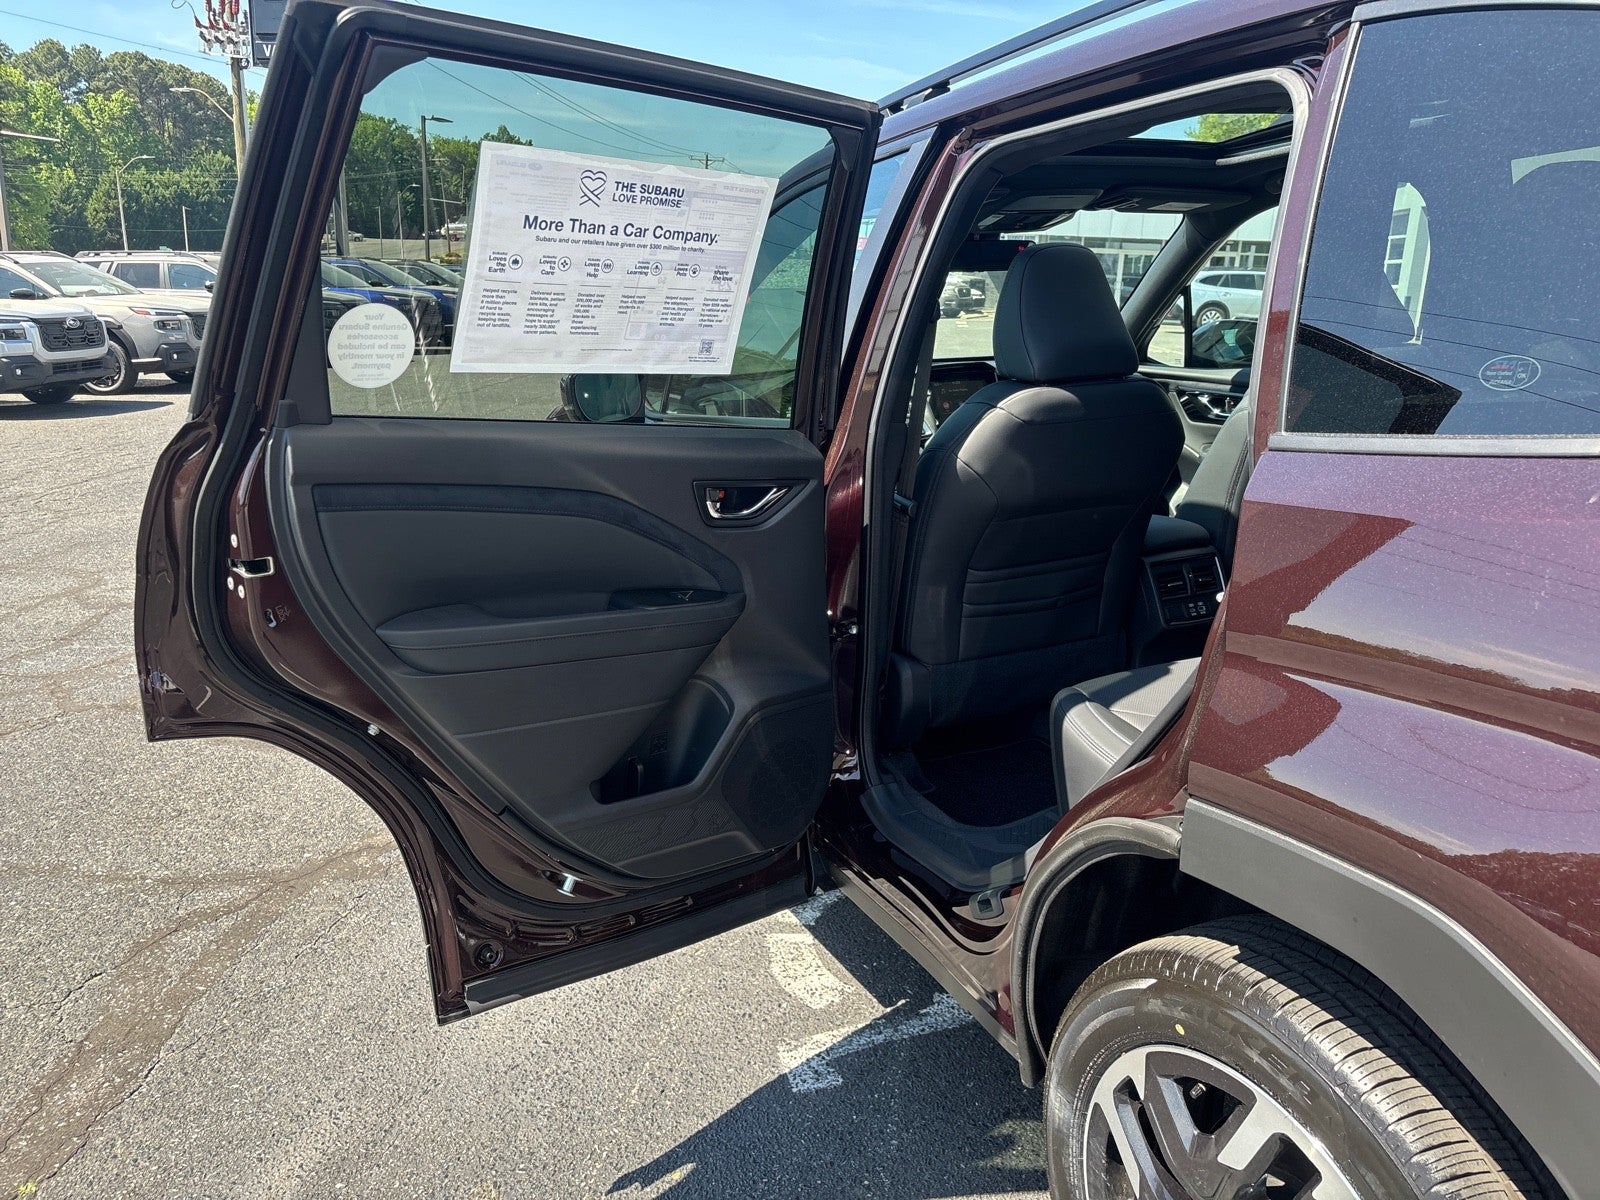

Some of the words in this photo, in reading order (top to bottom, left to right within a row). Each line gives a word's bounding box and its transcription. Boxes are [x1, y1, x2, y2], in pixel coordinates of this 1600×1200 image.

[612, 192, 637, 204] LOVE
[614, 181, 637, 193] THE
[640, 183, 685, 198] SUBARU
[523, 215, 564, 232] More
[569, 218, 606, 235] Than
[610, 225, 619, 236] a
[623, 223, 649, 238] Car
[652, 225, 719, 246] Company.
